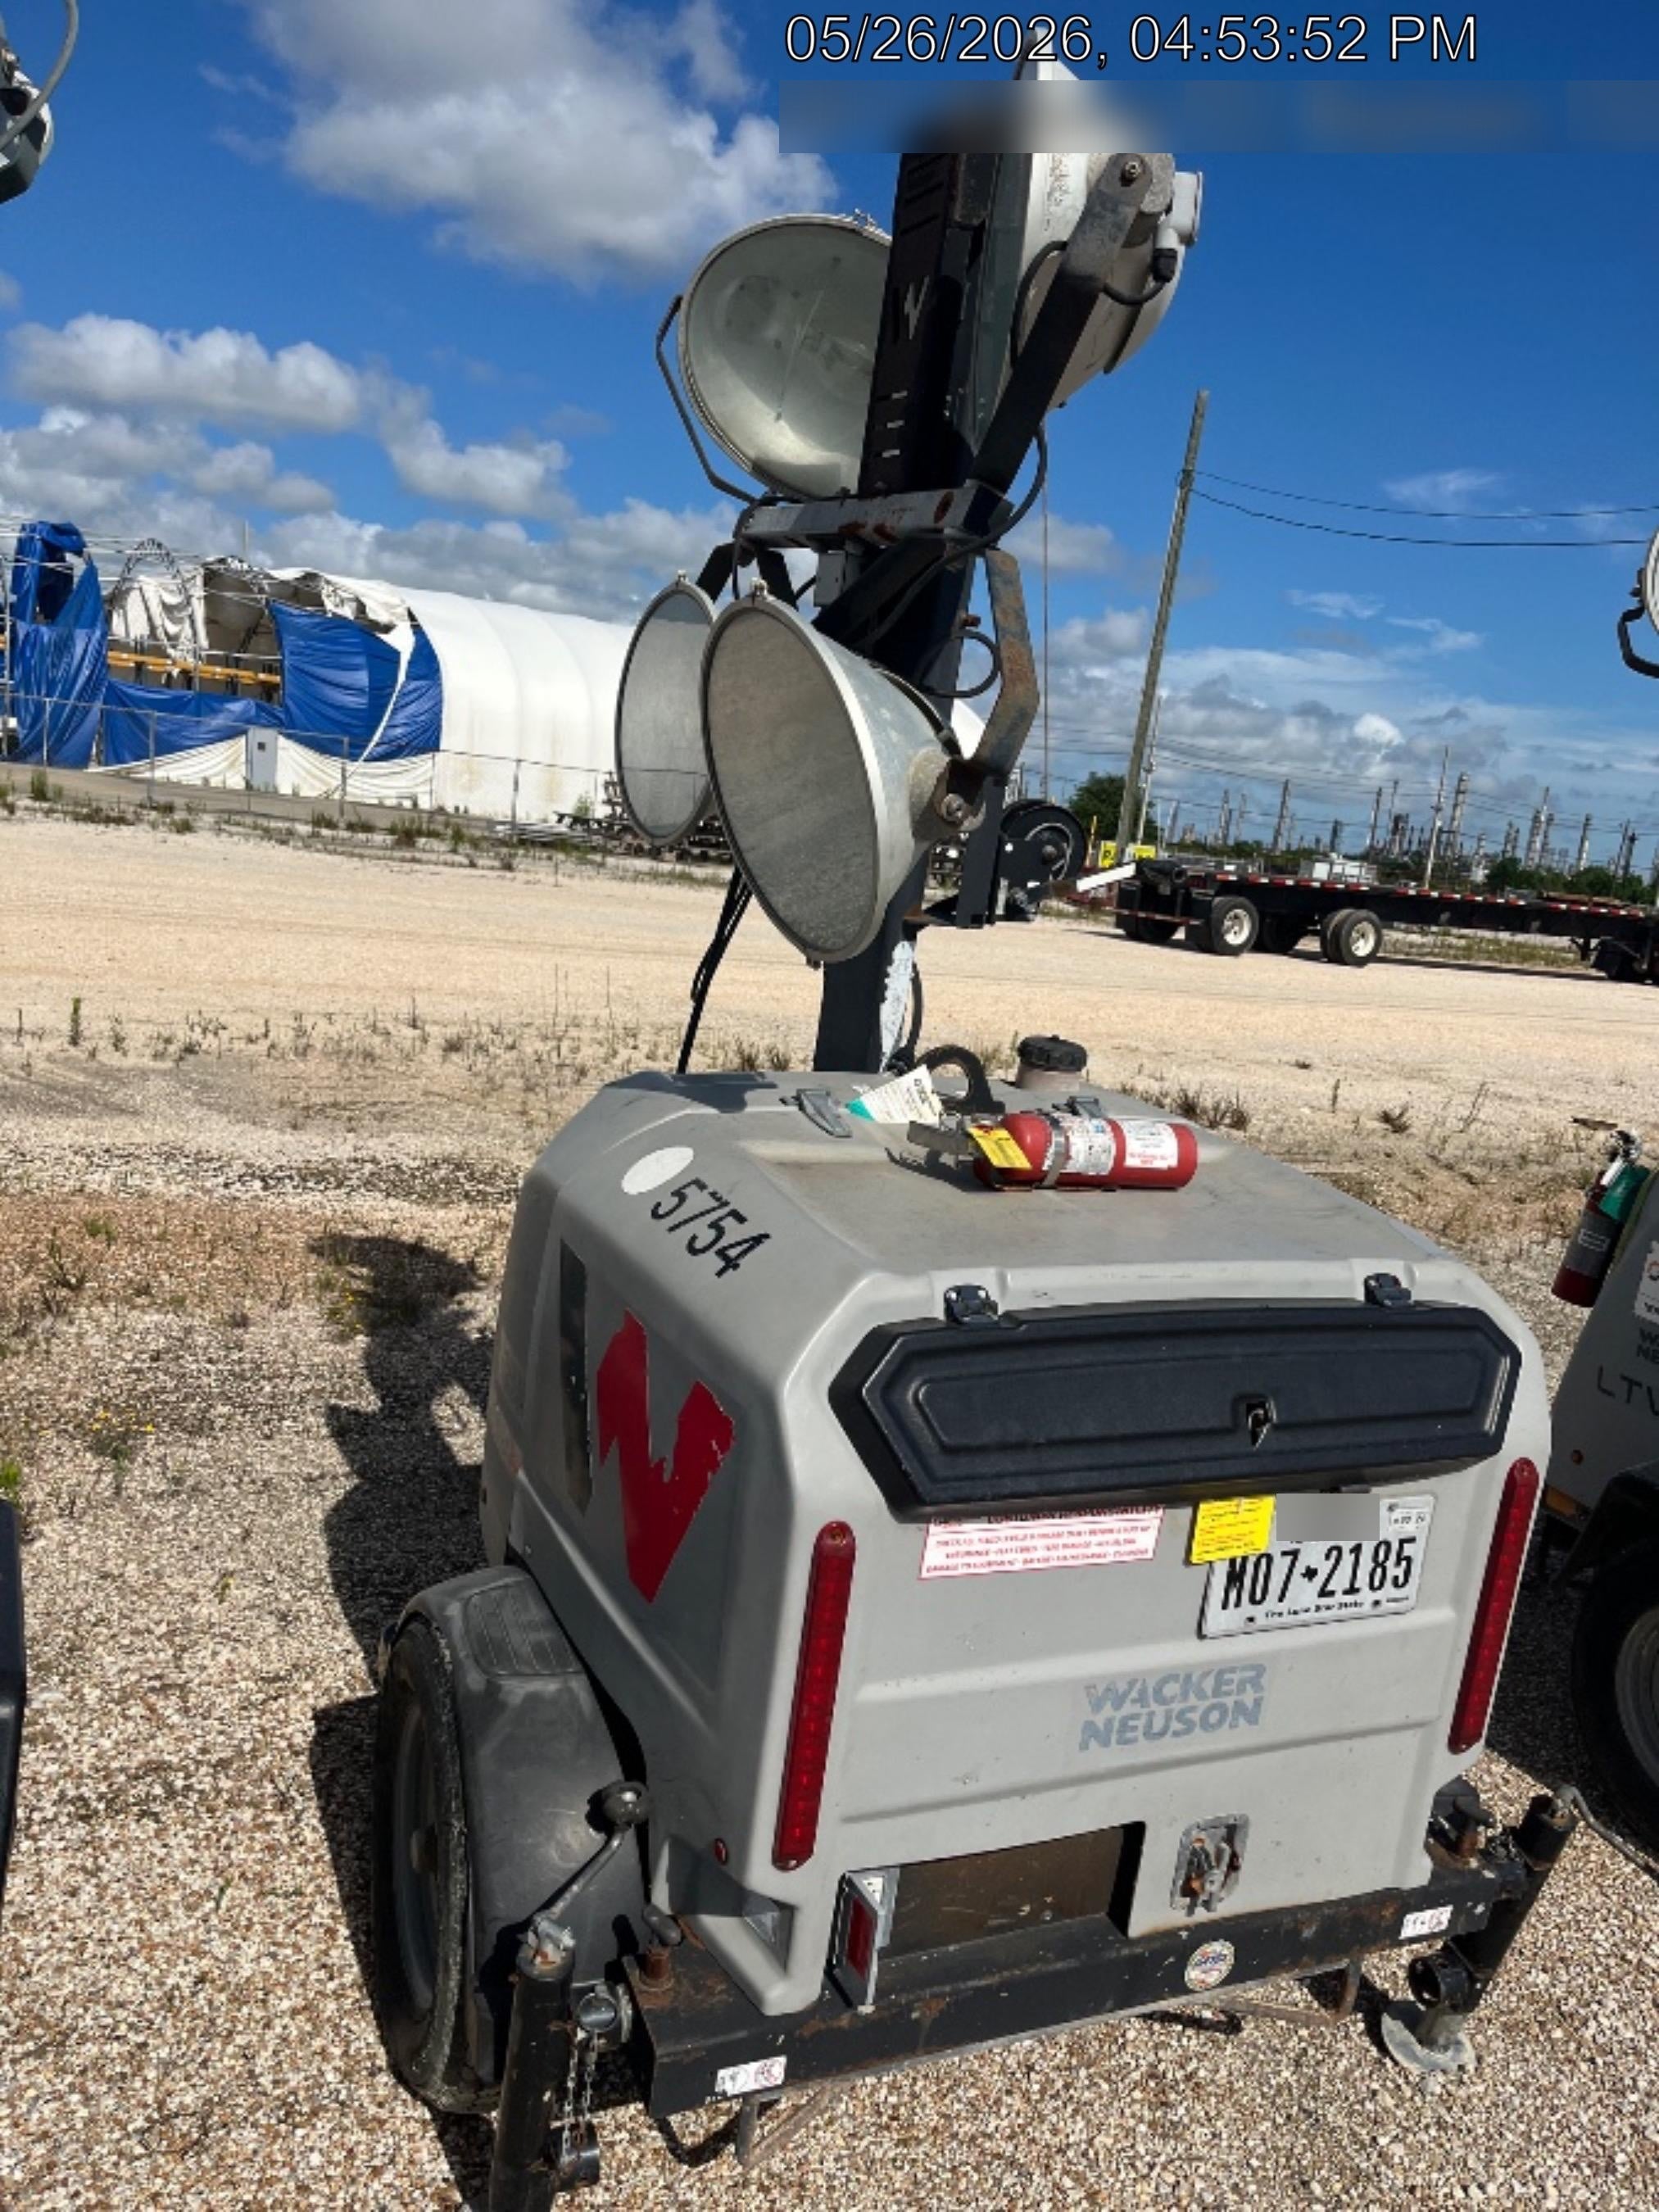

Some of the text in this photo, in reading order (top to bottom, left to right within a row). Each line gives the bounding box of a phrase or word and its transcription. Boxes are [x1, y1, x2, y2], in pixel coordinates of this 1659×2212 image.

[650, 1176, 772, 1278] 5754
[1084, 1663, 1267, 1715] WACKER
[1078, 1695, 1264, 1752] NEUSON
